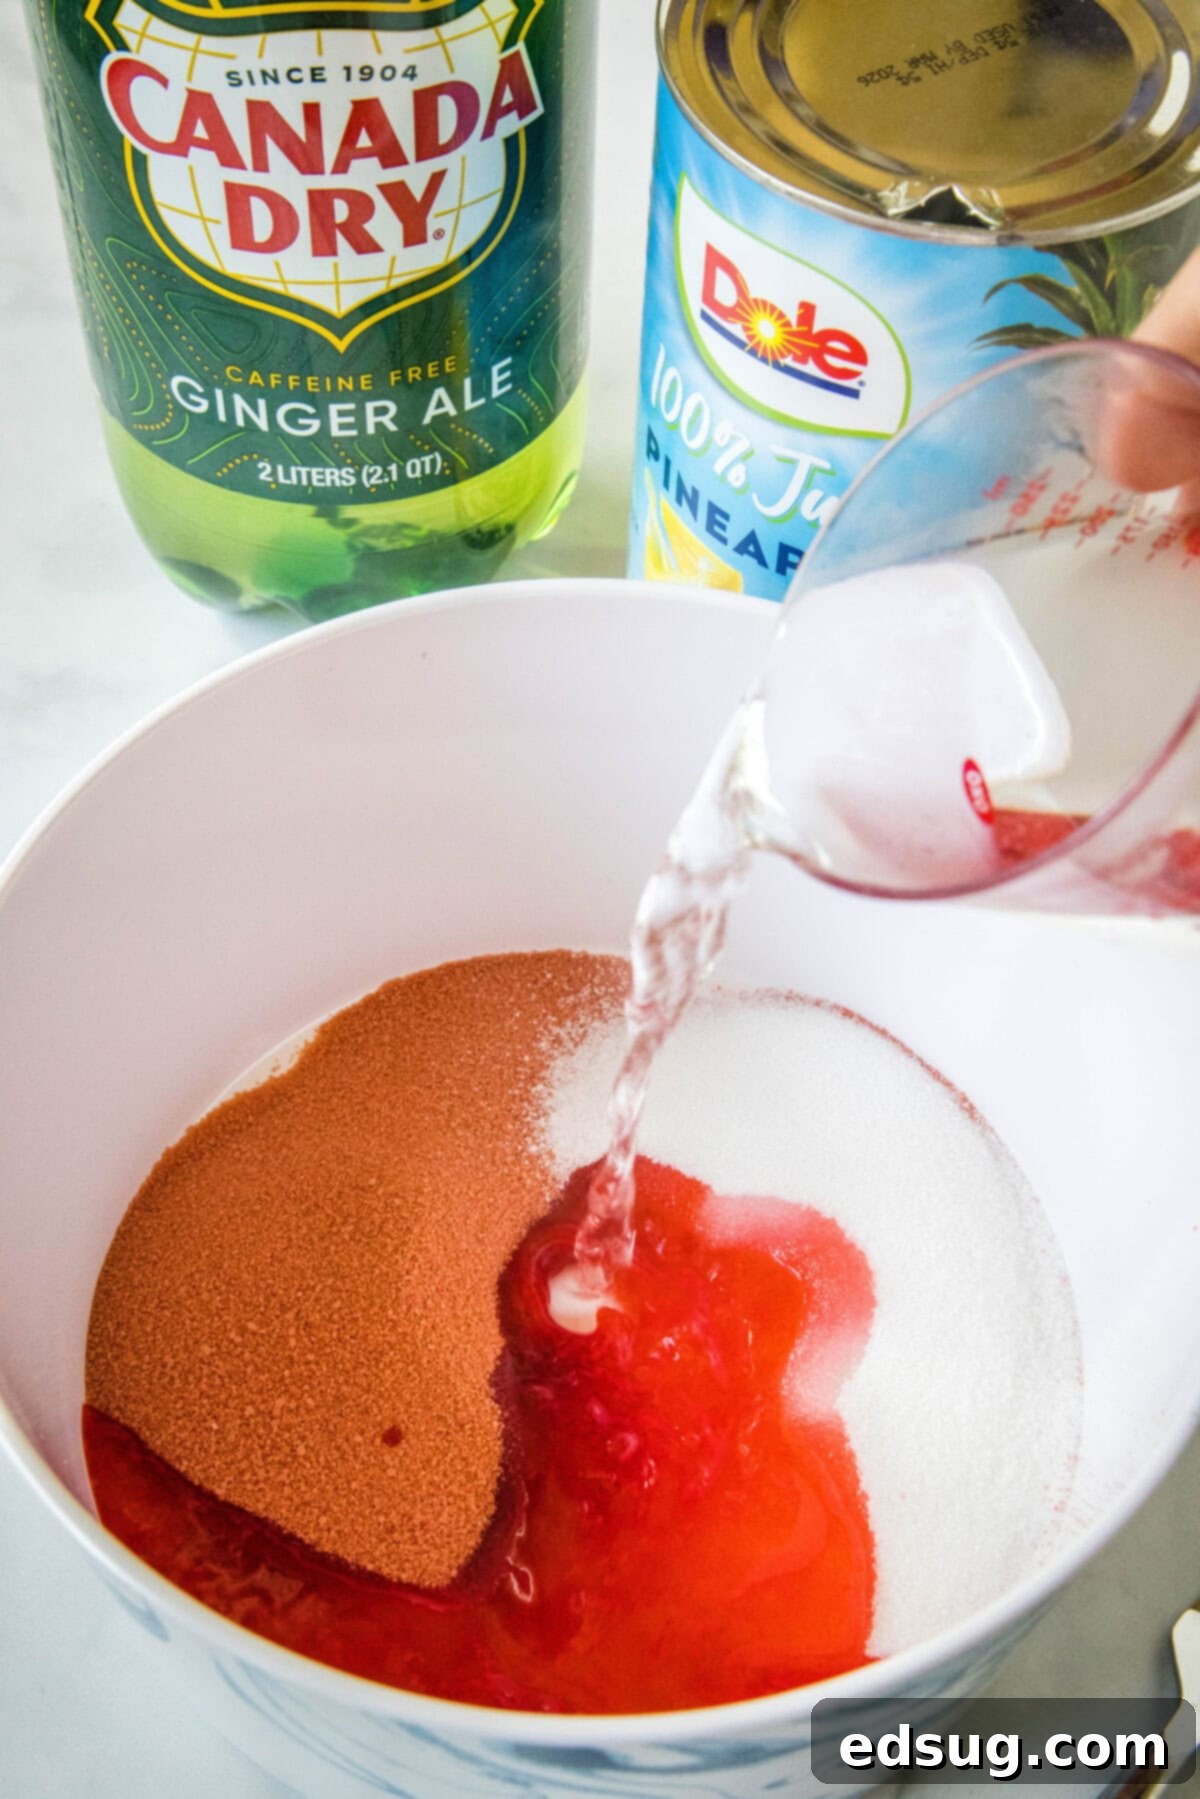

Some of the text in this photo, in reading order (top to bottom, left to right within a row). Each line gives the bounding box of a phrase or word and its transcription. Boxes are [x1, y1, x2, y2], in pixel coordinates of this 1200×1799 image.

[944, 39, 968, 56] BY
[974, 23, 1016, 43] USED
[226, 64, 419, 88] SINCE 1904
[856, 64, 899, 87] 2026
[106, 49, 538, 175] CANADA
[223, 169, 448, 258] DRY
[701, 240, 868, 381] Dole
[226, 356, 458, 392] CAFFEINE FREE
[170, 357, 513, 437] GINGER ALE
[650, 342, 747, 489] 100%
[257, 451, 443, 488] 2 LITERS (2.1 QT)
